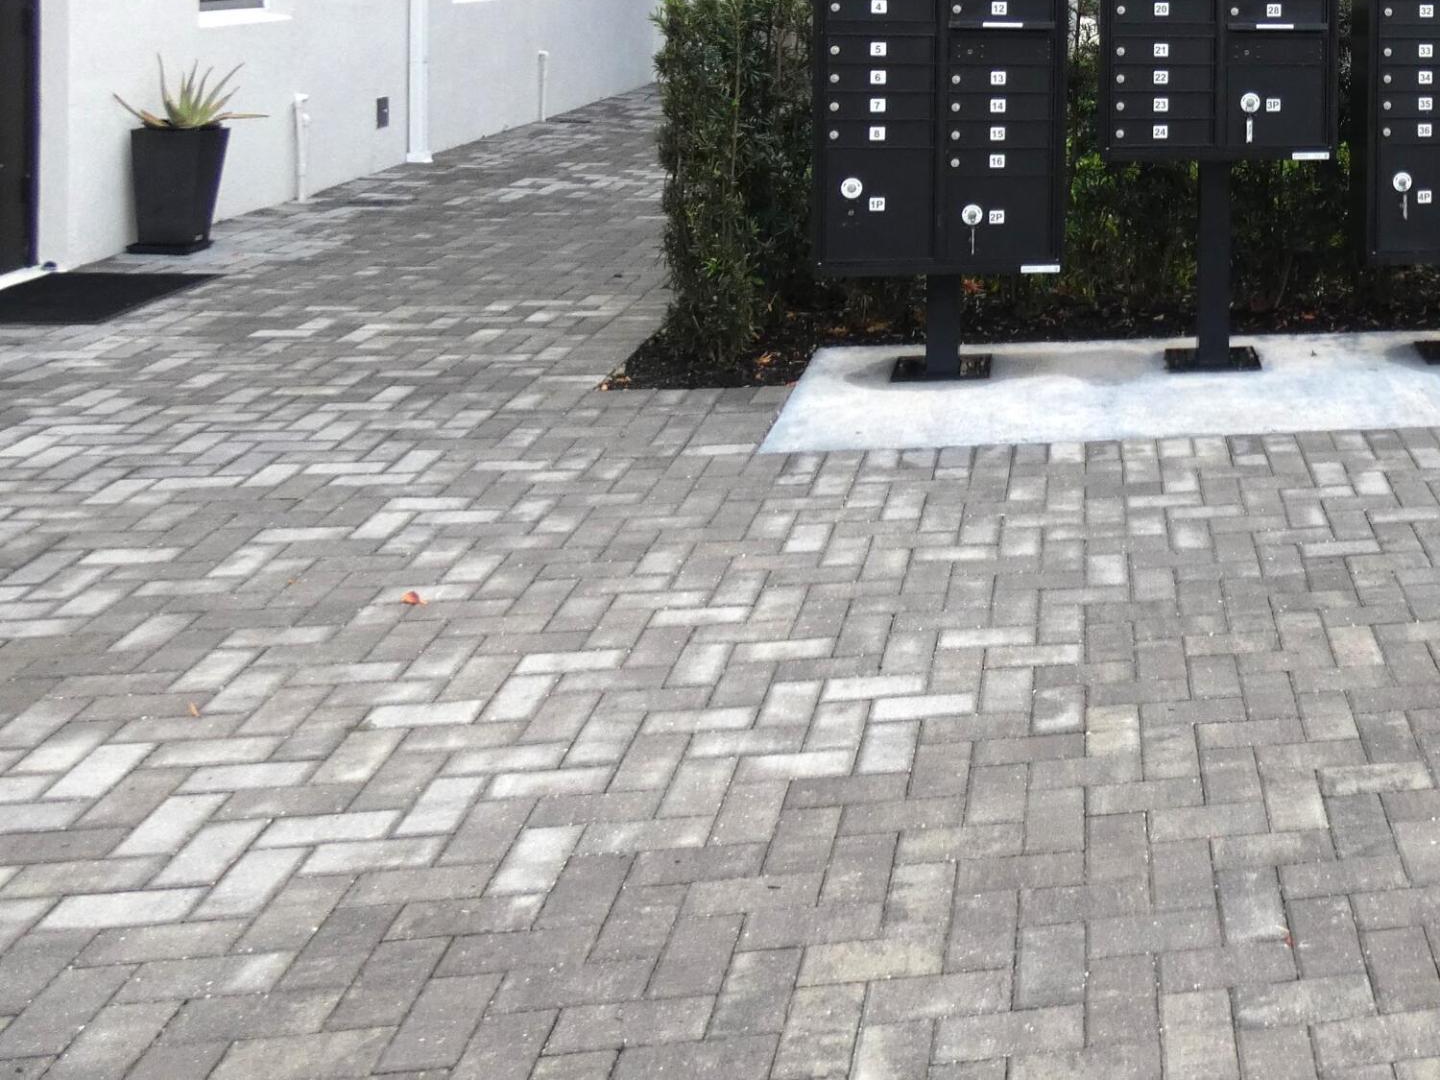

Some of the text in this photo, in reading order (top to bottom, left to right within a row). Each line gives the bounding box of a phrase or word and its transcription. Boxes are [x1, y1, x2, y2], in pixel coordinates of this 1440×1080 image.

[994, 4, 1005, 13] 12
[1156, 5, 1168, 14] 20
[1268, 6, 1280, 15] 28
[1421, 7, 1432, 16] 32
[1155, 46, 1166, 55] 21
[1420, 46, 1431, 55] 33
[993, 74, 1004, 83] 13
[1154, 73, 1167, 82] 22
[1420, 73, 1431, 82] 34
[992, 102, 1004, 110] 14
[1155, 100, 1166, 109] 23
[1267, 100, 1280, 110] 3P
[1420, 100, 1431, 108] 35
[992, 130, 1004, 138] 15
[1154, 128, 1166, 137] 24
[1419, 126, 1430, 135] 36
[992, 157, 1003, 166] 16
[1418, 192, 1431, 201] 4P
[871, 200, 884, 209] 1P
[990, 213, 1003, 222] 2P
